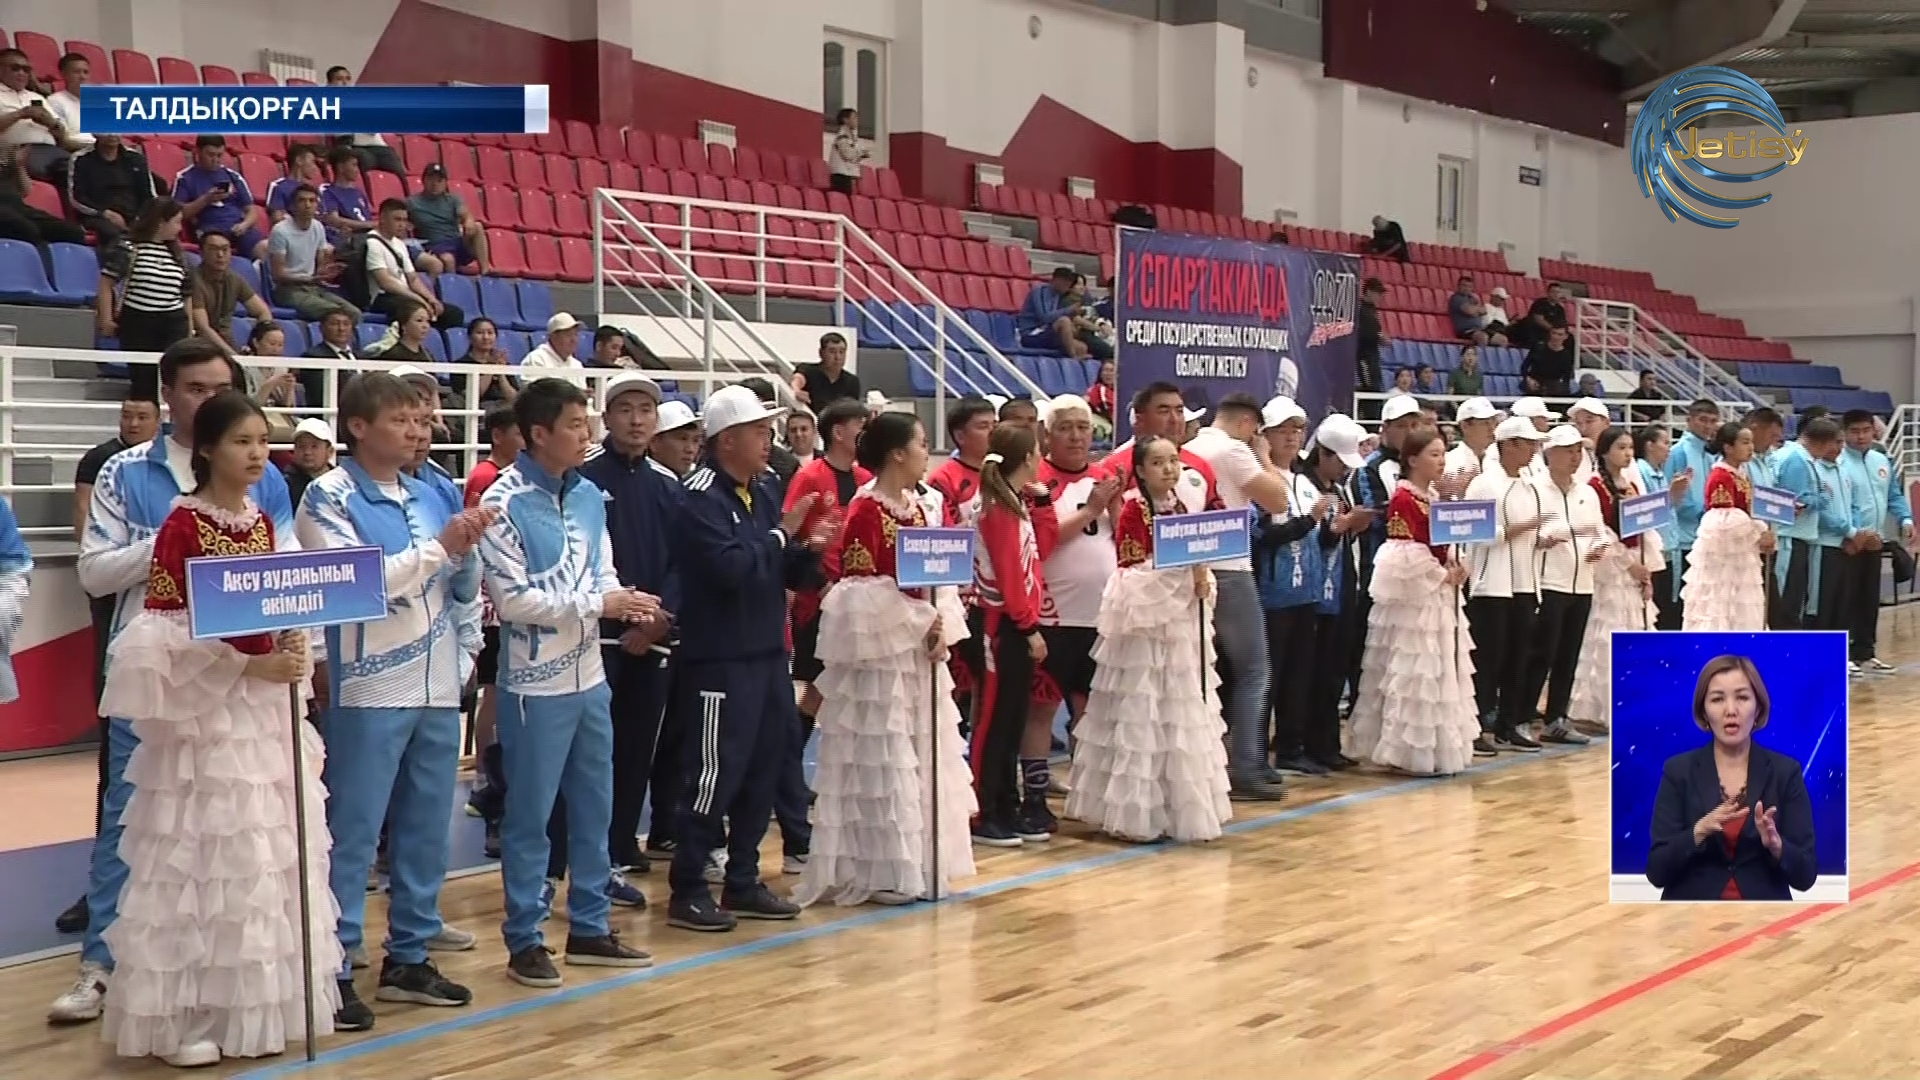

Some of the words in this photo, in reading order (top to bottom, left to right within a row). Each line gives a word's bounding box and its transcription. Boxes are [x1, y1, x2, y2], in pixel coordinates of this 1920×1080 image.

[1140, 253, 1289, 321] СПАРТАКИАДА
[1126, 319, 1157, 346] СРЕДИ
[1158, 321, 1242, 348] ГОСУДАРСТВЕННЫХ
[1243, 326, 1289, 352] СЛУЖАЩИХ
[1176, 353, 1215, 376] ОБЛАСТИ
[263, 563, 356, 589] ауданының
[261, 589, 324, 617] әкімдігі
